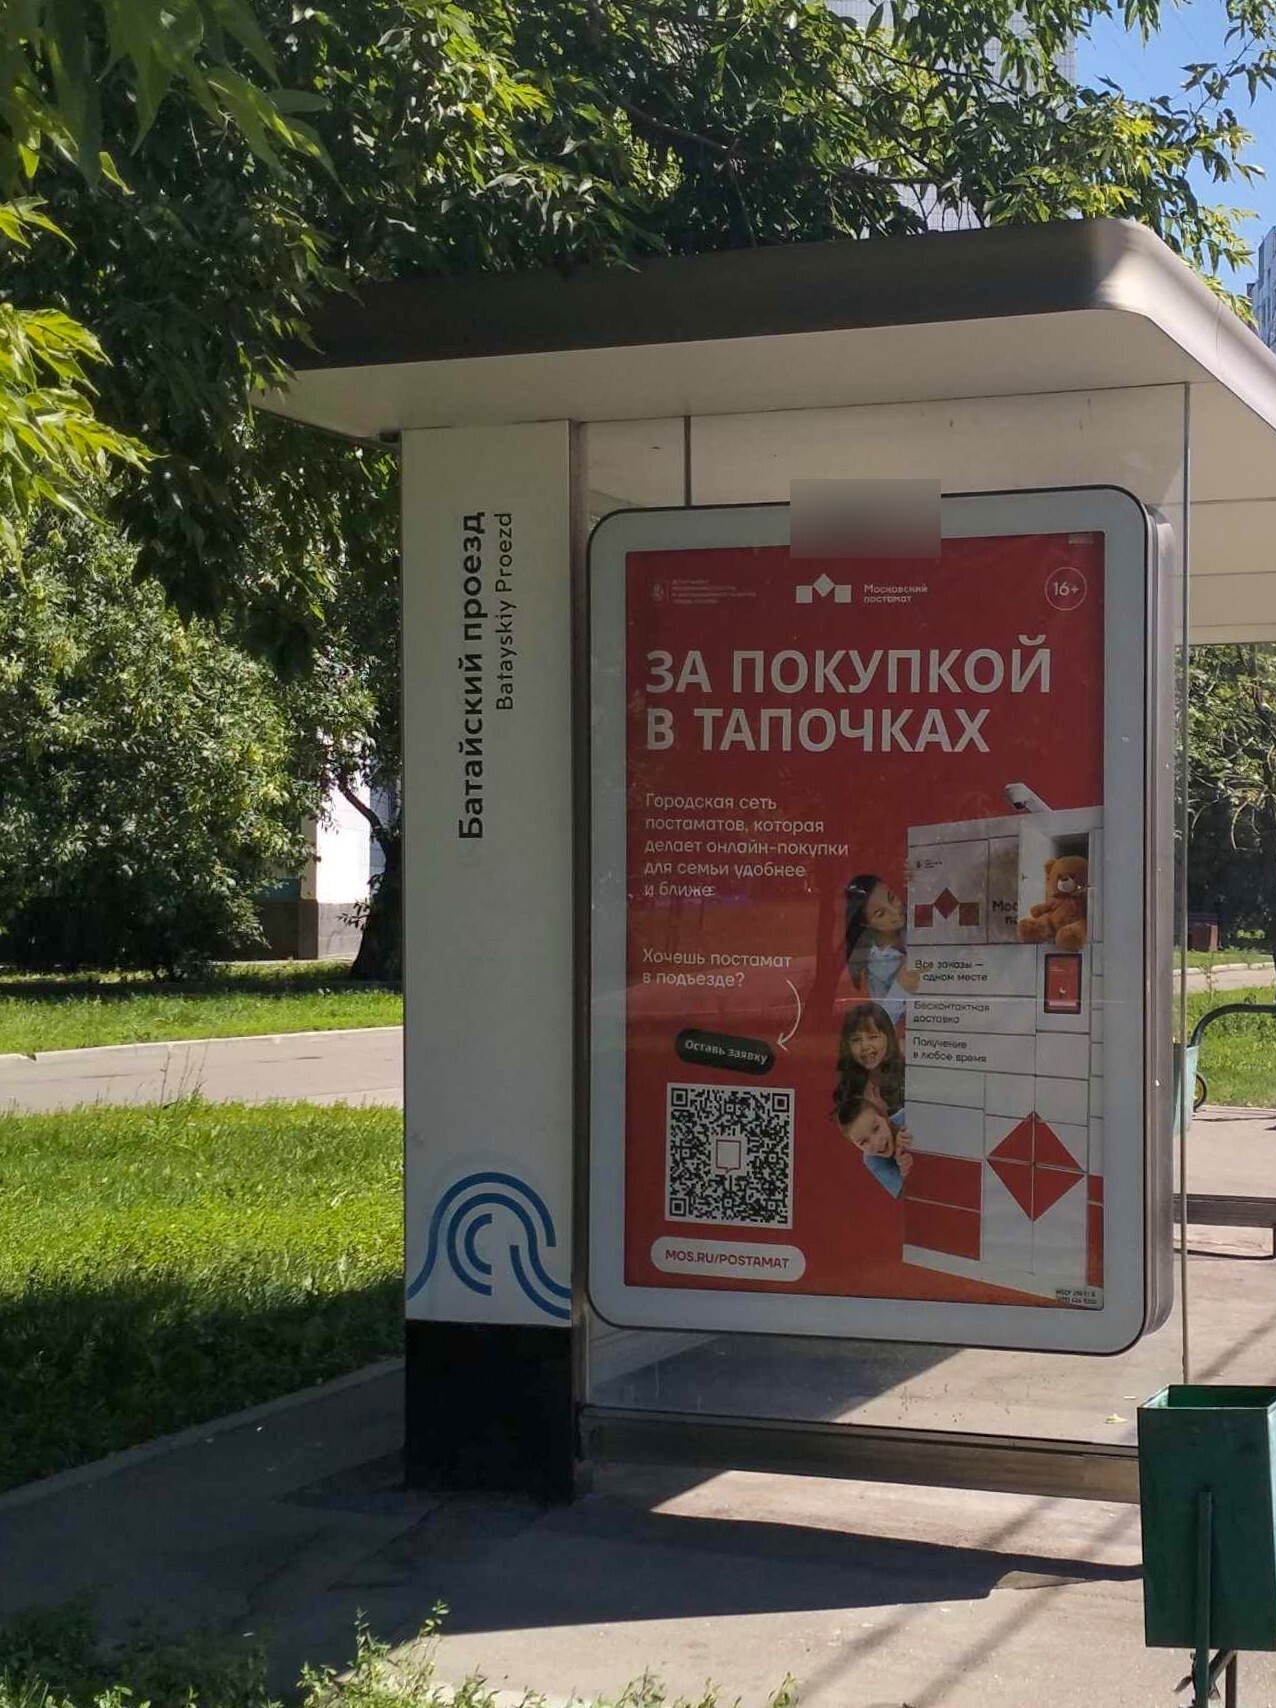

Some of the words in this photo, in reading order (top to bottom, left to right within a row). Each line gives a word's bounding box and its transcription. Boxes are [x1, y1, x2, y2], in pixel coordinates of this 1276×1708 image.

[494, 512, 513, 592] Proezd
[463, 511, 487, 641] проезд
[863, 583, 929, 594] Московский
[1053, 580, 1080, 597] 16+
[496, 600, 517, 710] Batayskiy
[646, 650, 712, 693] ЗА
[732, 634, 1052, 694] ПОКУПКОЙ
[646, 708, 675, 750] В
[694, 707, 991, 753] ТАПОЧКАХ
[458, 653, 483, 839] Батайский
[645, 793, 734, 811] Городская
[739, 797, 777, 810] сеть
[645, 818, 749, 834] постаматов,
[754, 820, 824, 836] которая
[644, 840, 701, 854] делает
[706, 840, 849, 858] онлайн-покупки
[644, 863, 672, 876] для
[677, 863, 729, 876] семьи
[734, 861, 806, 878] удобнее
[644, 885, 654, 897] и
[659, 881, 715, 897] ближе
[643, 948, 705, 965] Хочешь
[710, 954, 792, 969] постамат
[914, 959, 934, 969] Все
[937, 961, 973, 969] заказы
[643, 972, 651, 983] в
[656, 971, 745, 988] подъезде?
[922, 974, 954, 982] одном
[957, 974, 988, 982] месте
[913, 1001, 990, 1012] Бесконтактная
[913, 1015, 960, 1024] доставка
[913, 1036, 968, 1049] Получение
[684, 1039, 725, 1056] Оставь
[727, 1048, 768, 1066] заявку
[921, 1051, 953, 1061] любое
[956, 1054, 987, 1064] время
[664, 1249, 790, 1269] MOS.RU/POSTAMAT
